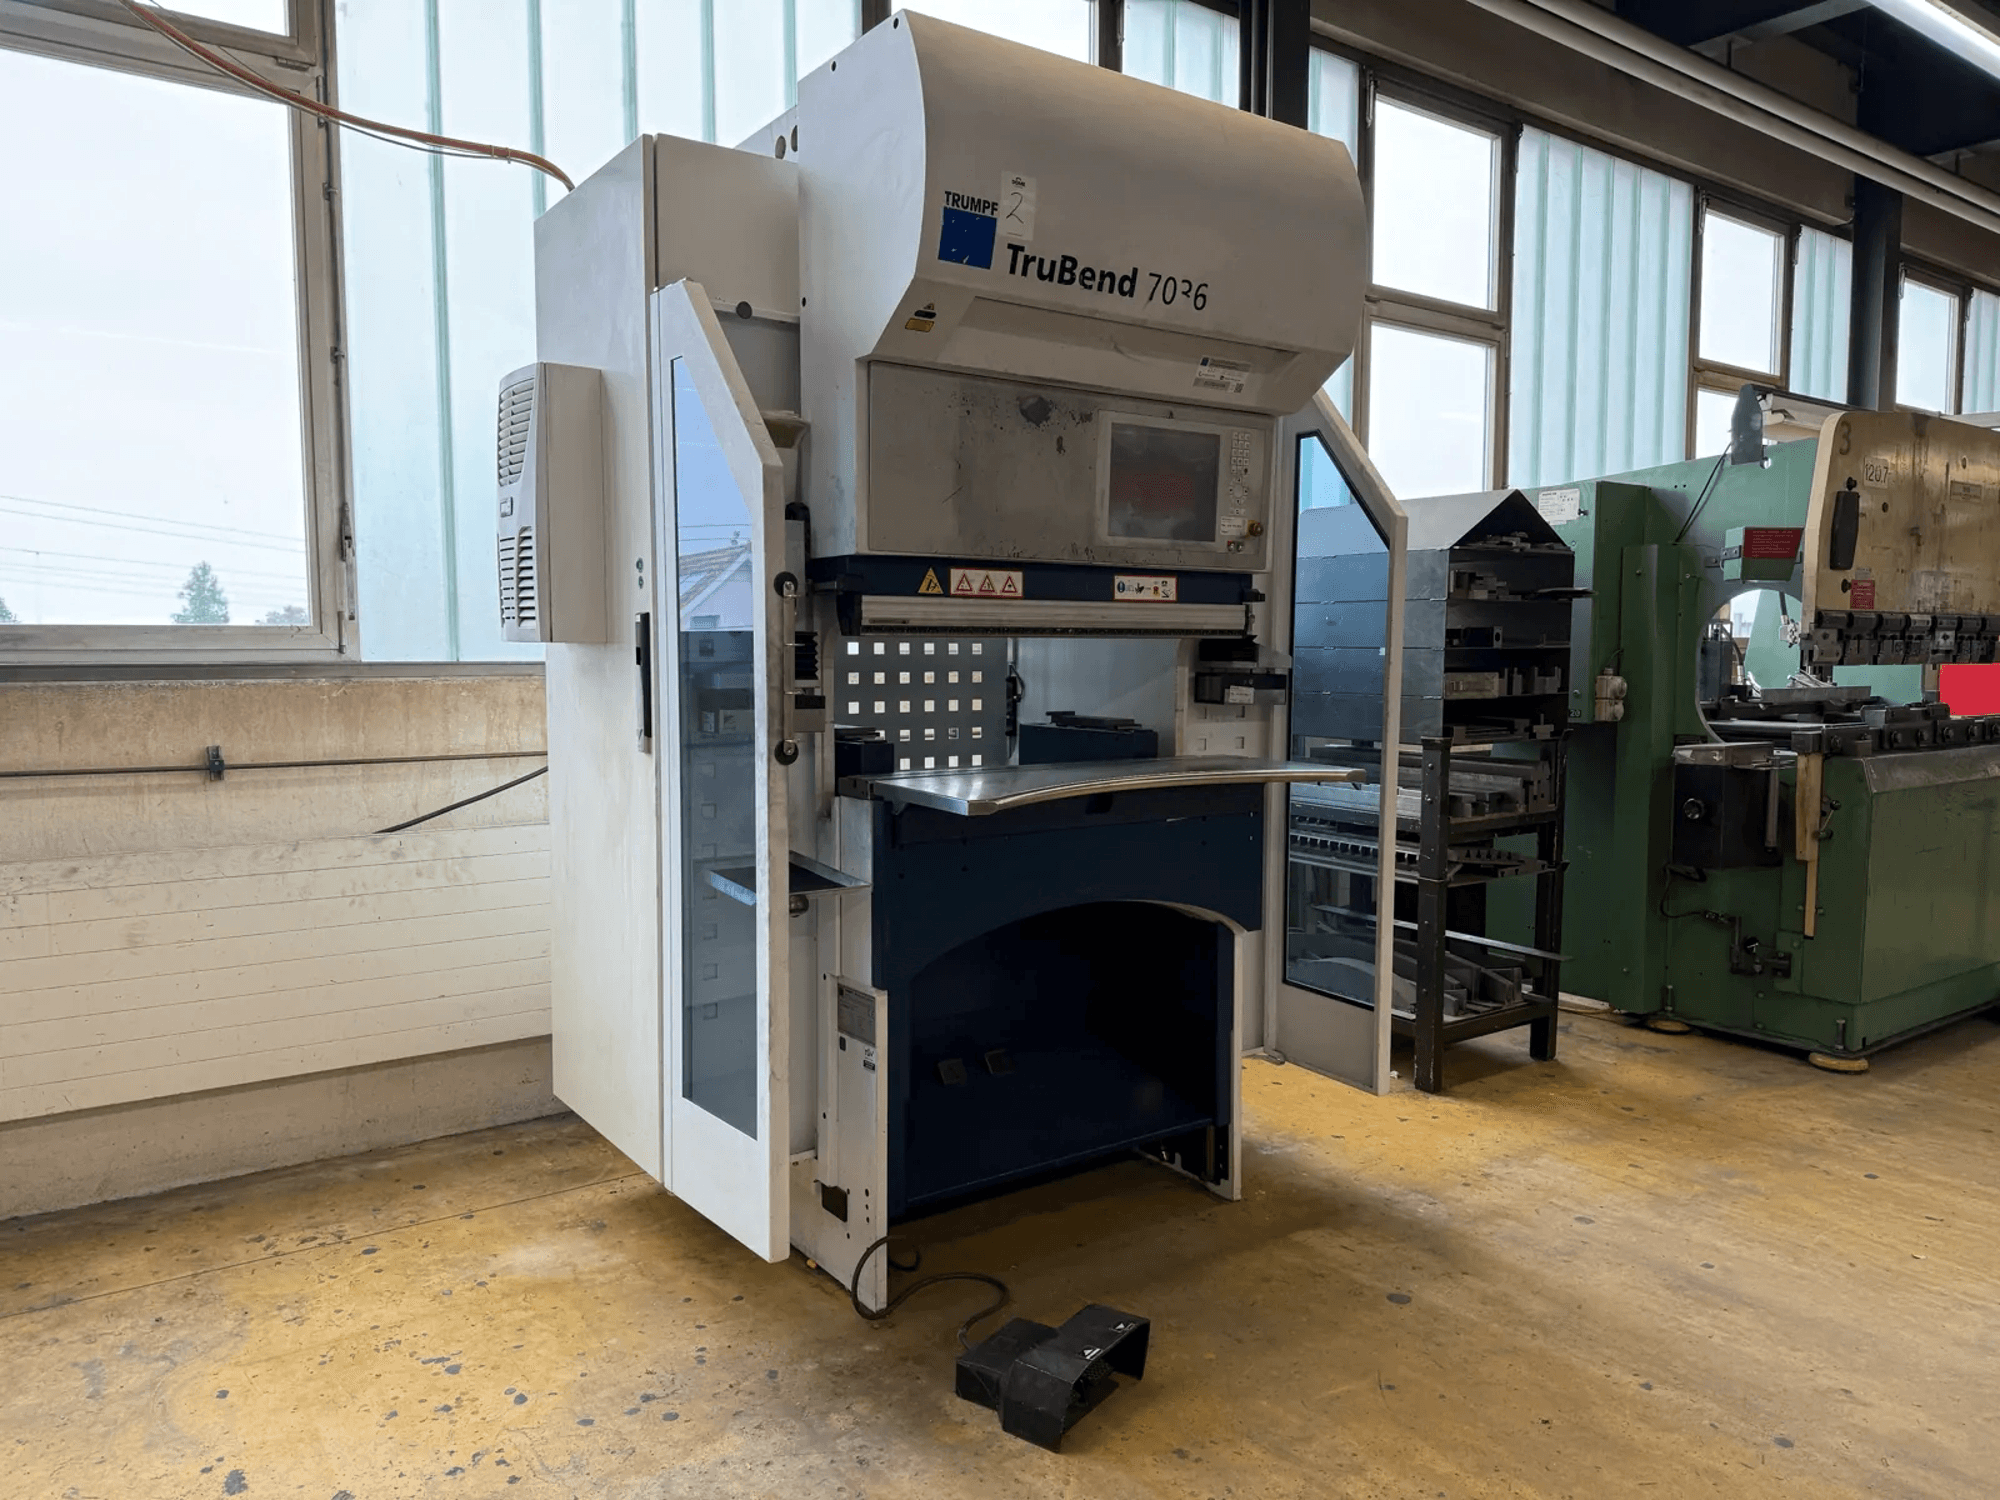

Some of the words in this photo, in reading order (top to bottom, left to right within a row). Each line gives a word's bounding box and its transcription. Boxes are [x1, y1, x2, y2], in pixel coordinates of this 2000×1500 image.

[945, 190, 999, 216] TRUMPF
[1006, 191, 1025, 225] 2
[1007, 243, 1138, 298] TruBend
[1839, 420, 1851, 455] 3
